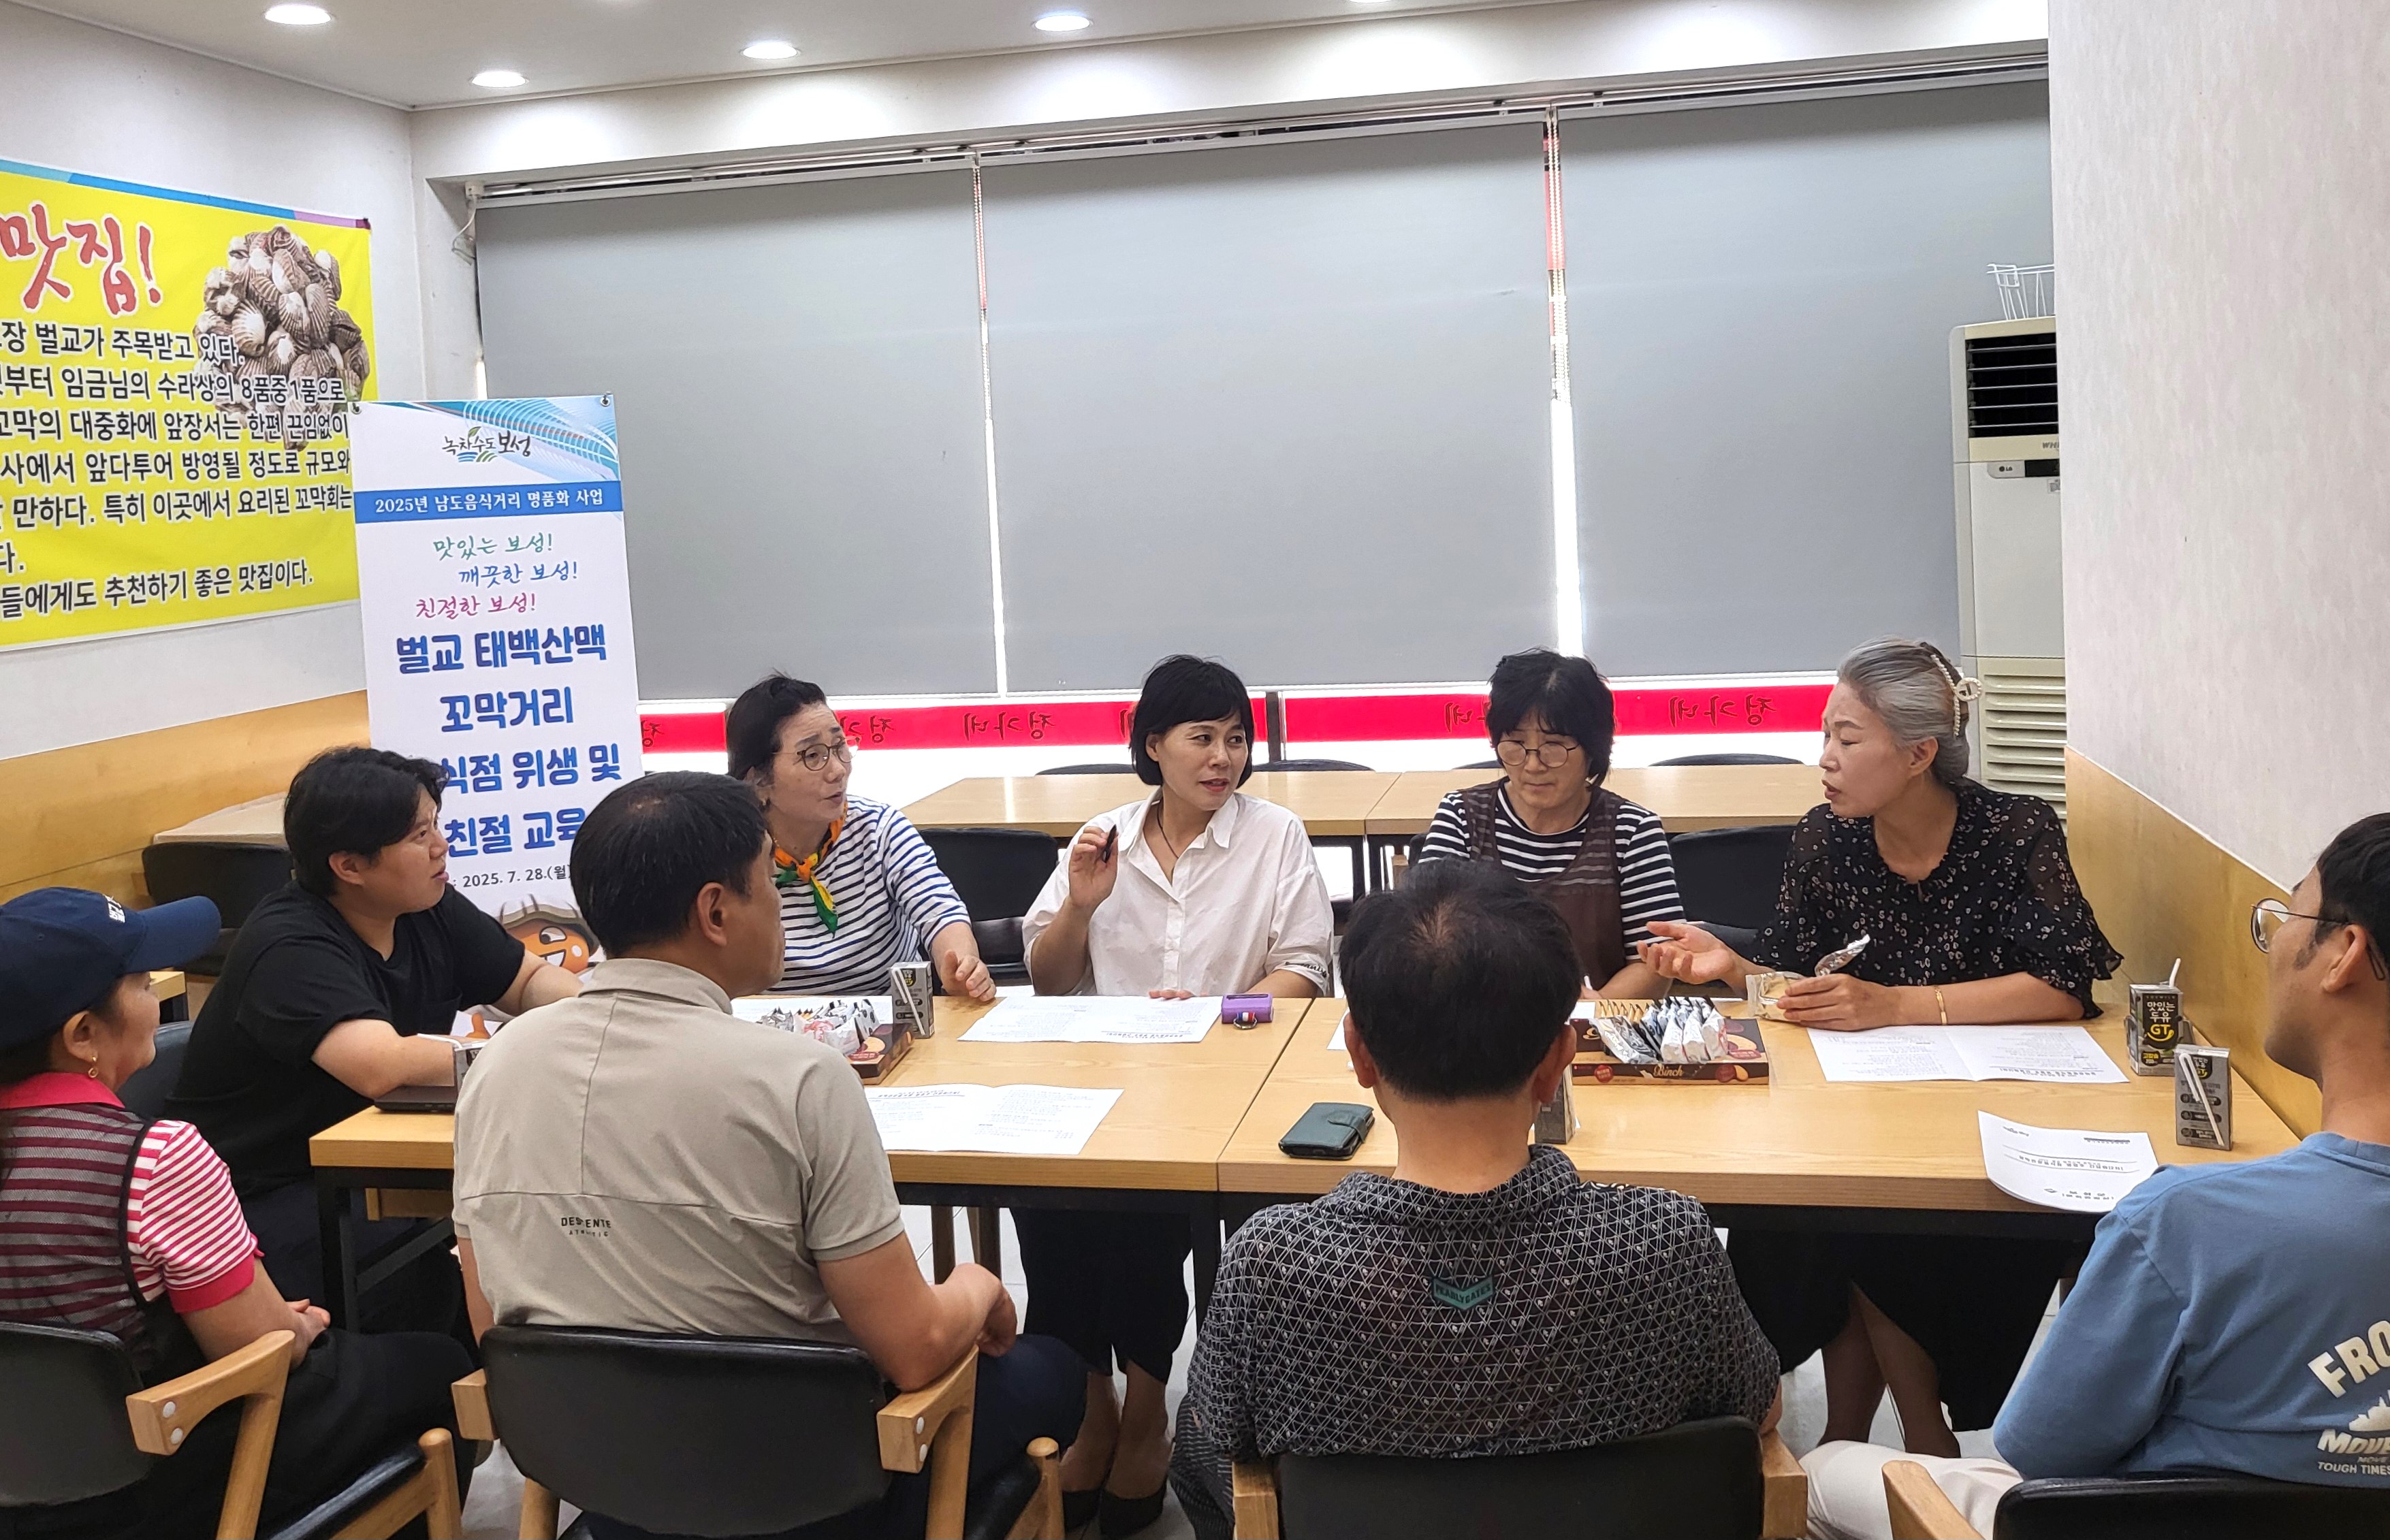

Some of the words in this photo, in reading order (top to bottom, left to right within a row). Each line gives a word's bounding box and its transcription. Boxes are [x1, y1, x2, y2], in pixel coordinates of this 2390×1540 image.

[1, 204, 161, 315] 맛집!
[0, 321, 27, 353] 장
[35, 323, 104, 357] 벌교가
[112, 330, 195, 360] 주목받고
[200, 334, 245, 364] 있다.
[0, 364, 53, 397] 부터
[62, 368, 150, 400] 임금님의
[157, 372, 233, 402] 수라상의
[70, 411, 157, 441] 대중화에
[164, 412, 241, 440] 앞장서는
[247, 413, 281, 440] 한편
[287, 414, 349, 440] 끈임없이
[442, 434, 496, 455] 녹차수도
[498, 430, 531, 458] 보성
[1, 453, 75, 484] 사에서
[86, 452, 173, 483] 앞다투어
[182, 451, 241, 480] 방영될
[249, 450, 300, 478] 정도로
[306, 449, 351, 476] 규모와
[14, 495, 95, 528] 만하다.
[103, 493, 145, 524] 특히
[153, 492, 230, 520] 이곳에서
[238, 487, 290, 515] 요리된
[295, 484, 352, 511] 꼬막회는
[375, 496, 428, 513] 2025년
[434, 492, 521, 512] 남도음식거리
[527, 490, 571, 509] 명품화
[575, 488, 603, 505] 사업
[433, 535, 498, 561] 맛있는
[505, 532, 552, 553] 보성!
[0, 581, 97, 618] 들에게도
[105, 571, 187, 606] 추천하기
[194, 567, 232, 598] 좋은
[239, 559, 313, 592] 맛집이다.
[458, 563, 523, 588] 깨끗한
[530, 560, 577, 581] 보성!
[416, 595, 481, 620] 친절한
[488, 592, 535, 613] 보성!
[396, 633, 465, 674] 벌교
[475, 624, 607, 669] 태백산맥
[440, 686, 574, 733] 꼬막거리
[513, 746, 579, 789] 위생
[588, 743, 622, 782] 및
[444, 814, 513, 858] 친절
[462, 872, 503, 888] 2025.
[507, 870, 521, 884] 7.
[2147, 1001, 2176, 1012] 맛있는
[2149, 1012, 2171, 1023] 두유
[2150, 1024, 2171, 1036] GT
[1653, 1063, 1685, 1078] Binch
[560, 1217, 611, 1229] DESENTE
[2318, 1462, 2357, 1475] TOUGH
